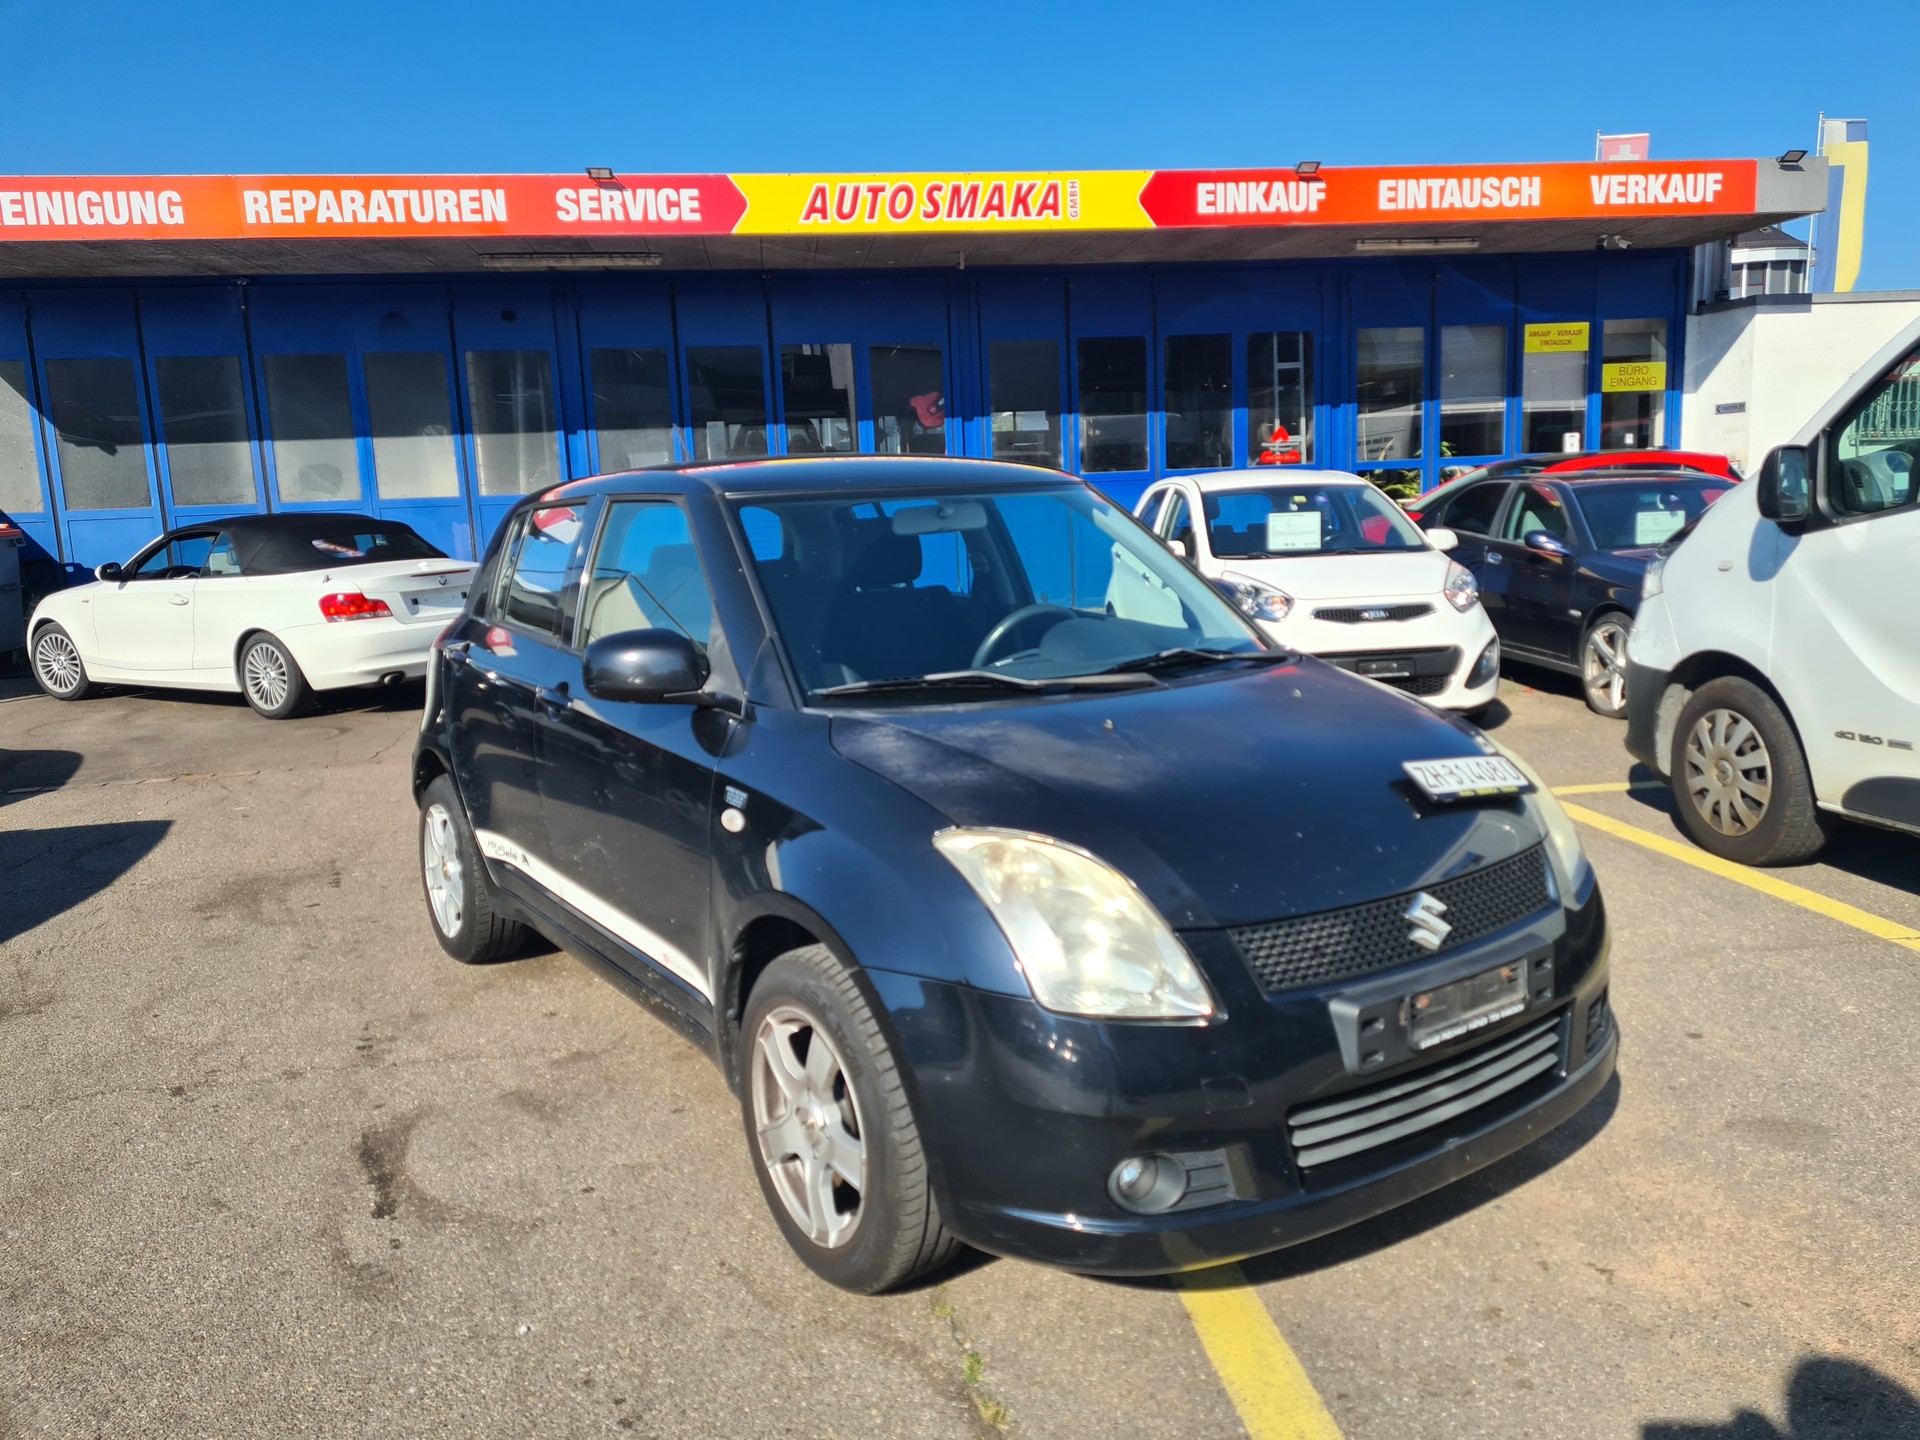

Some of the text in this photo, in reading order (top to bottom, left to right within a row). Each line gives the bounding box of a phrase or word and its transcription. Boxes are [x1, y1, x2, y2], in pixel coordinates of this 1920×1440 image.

[555, 187, 702, 223] SERVICE
[801, 180, 1062, 222] AUTO SMAKA
[1068, 179, 1080, 219] GMBH
[1196, 181, 1327, 214] EINKAUF
[1378, 176, 1541, 211] EINTAUSCH
[1590, 172, 1723, 205] VERKAUF
[0, 190, 185, 226] EINIGUNG
[244, 189, 508, 225] REPARATUREN
[1540, 339, 1572, 347] EINTAUSCH
[1556, 329, 1584, 337] VERKAUF
[1610, 376, 1657, 388] EINGANG
[1618, 364, 1650, 376] BÜRO
